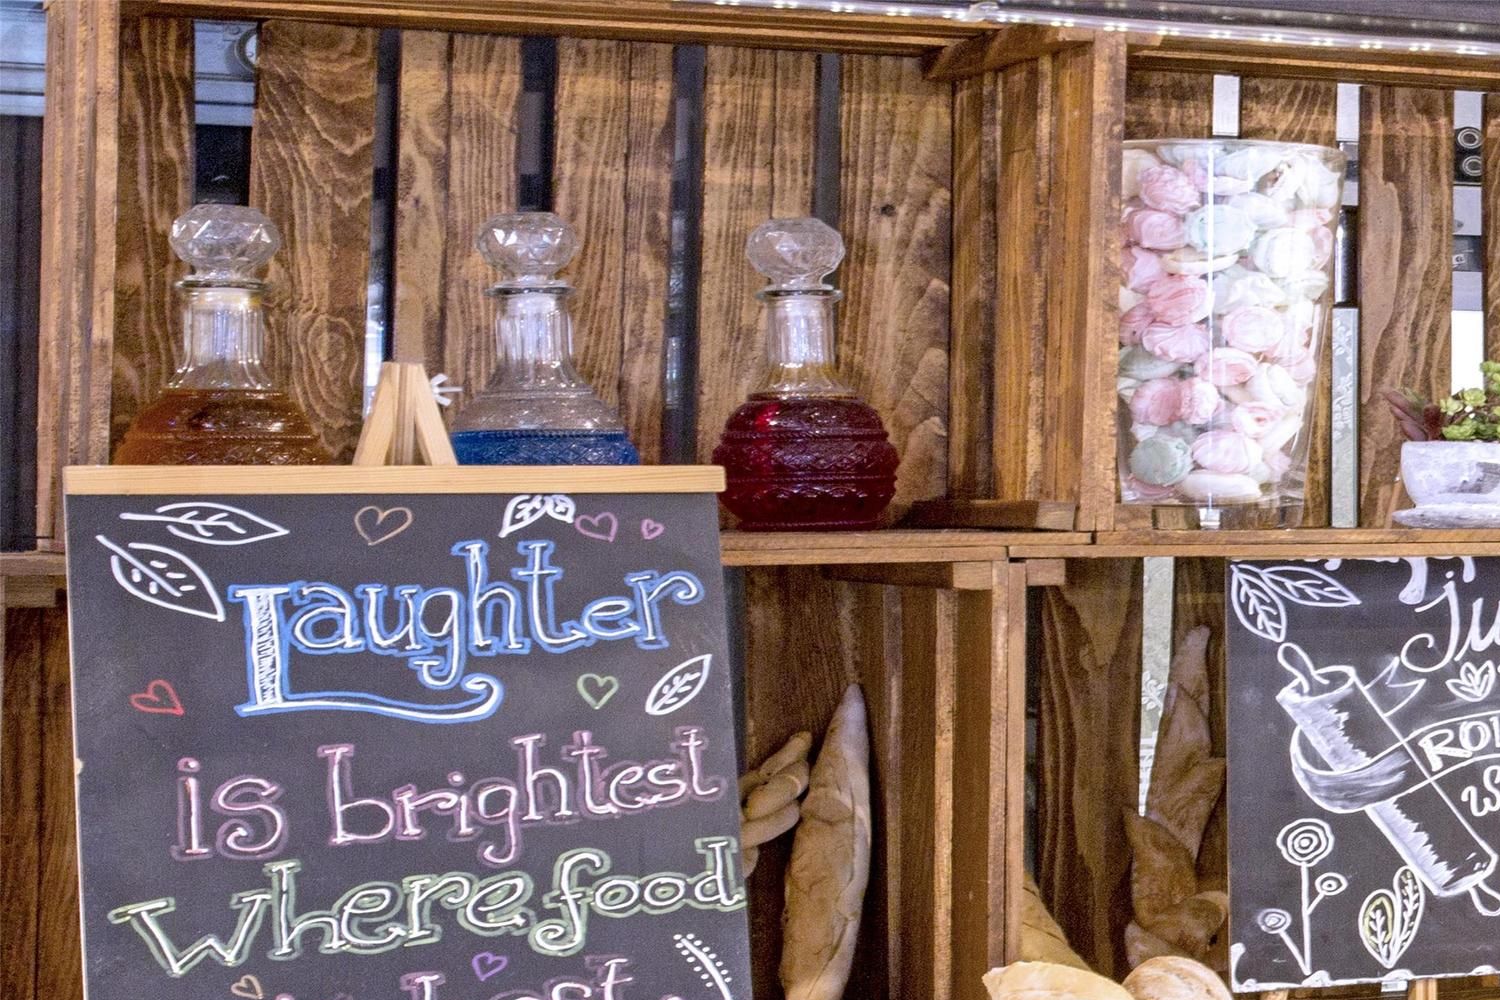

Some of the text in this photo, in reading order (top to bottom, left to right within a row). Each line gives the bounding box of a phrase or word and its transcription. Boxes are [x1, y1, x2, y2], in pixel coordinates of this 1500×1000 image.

[226, 540, 702, 722] Laughter
[171, 726, 722, 866] is brightest
[529, 836, 748, 956] food
